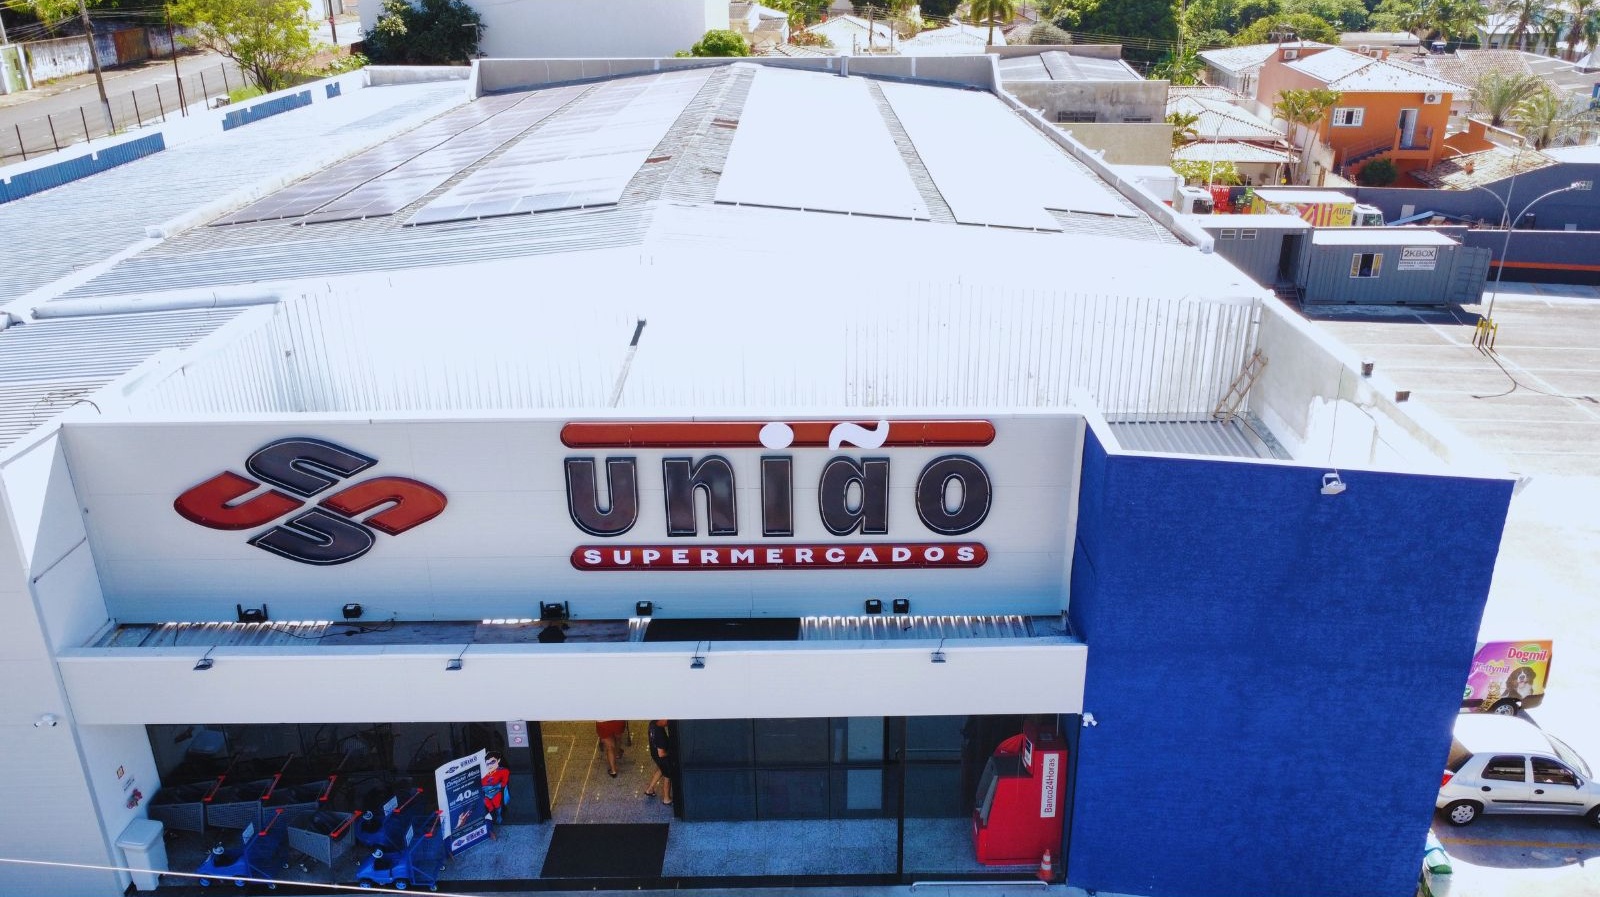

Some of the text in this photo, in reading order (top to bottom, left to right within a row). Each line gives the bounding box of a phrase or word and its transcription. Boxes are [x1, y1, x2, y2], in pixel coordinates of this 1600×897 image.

[1403, 249, 1434, 258] 2KBOX
[563, 419, 993, 538] união
[583, 546, 976, 565] SUPERMERCADOS
[1507, 647, 1548, 662] Dogmil
[1044, 758, 1056, 813] Banco24Horas
[456, 789, 472, 802] 40
